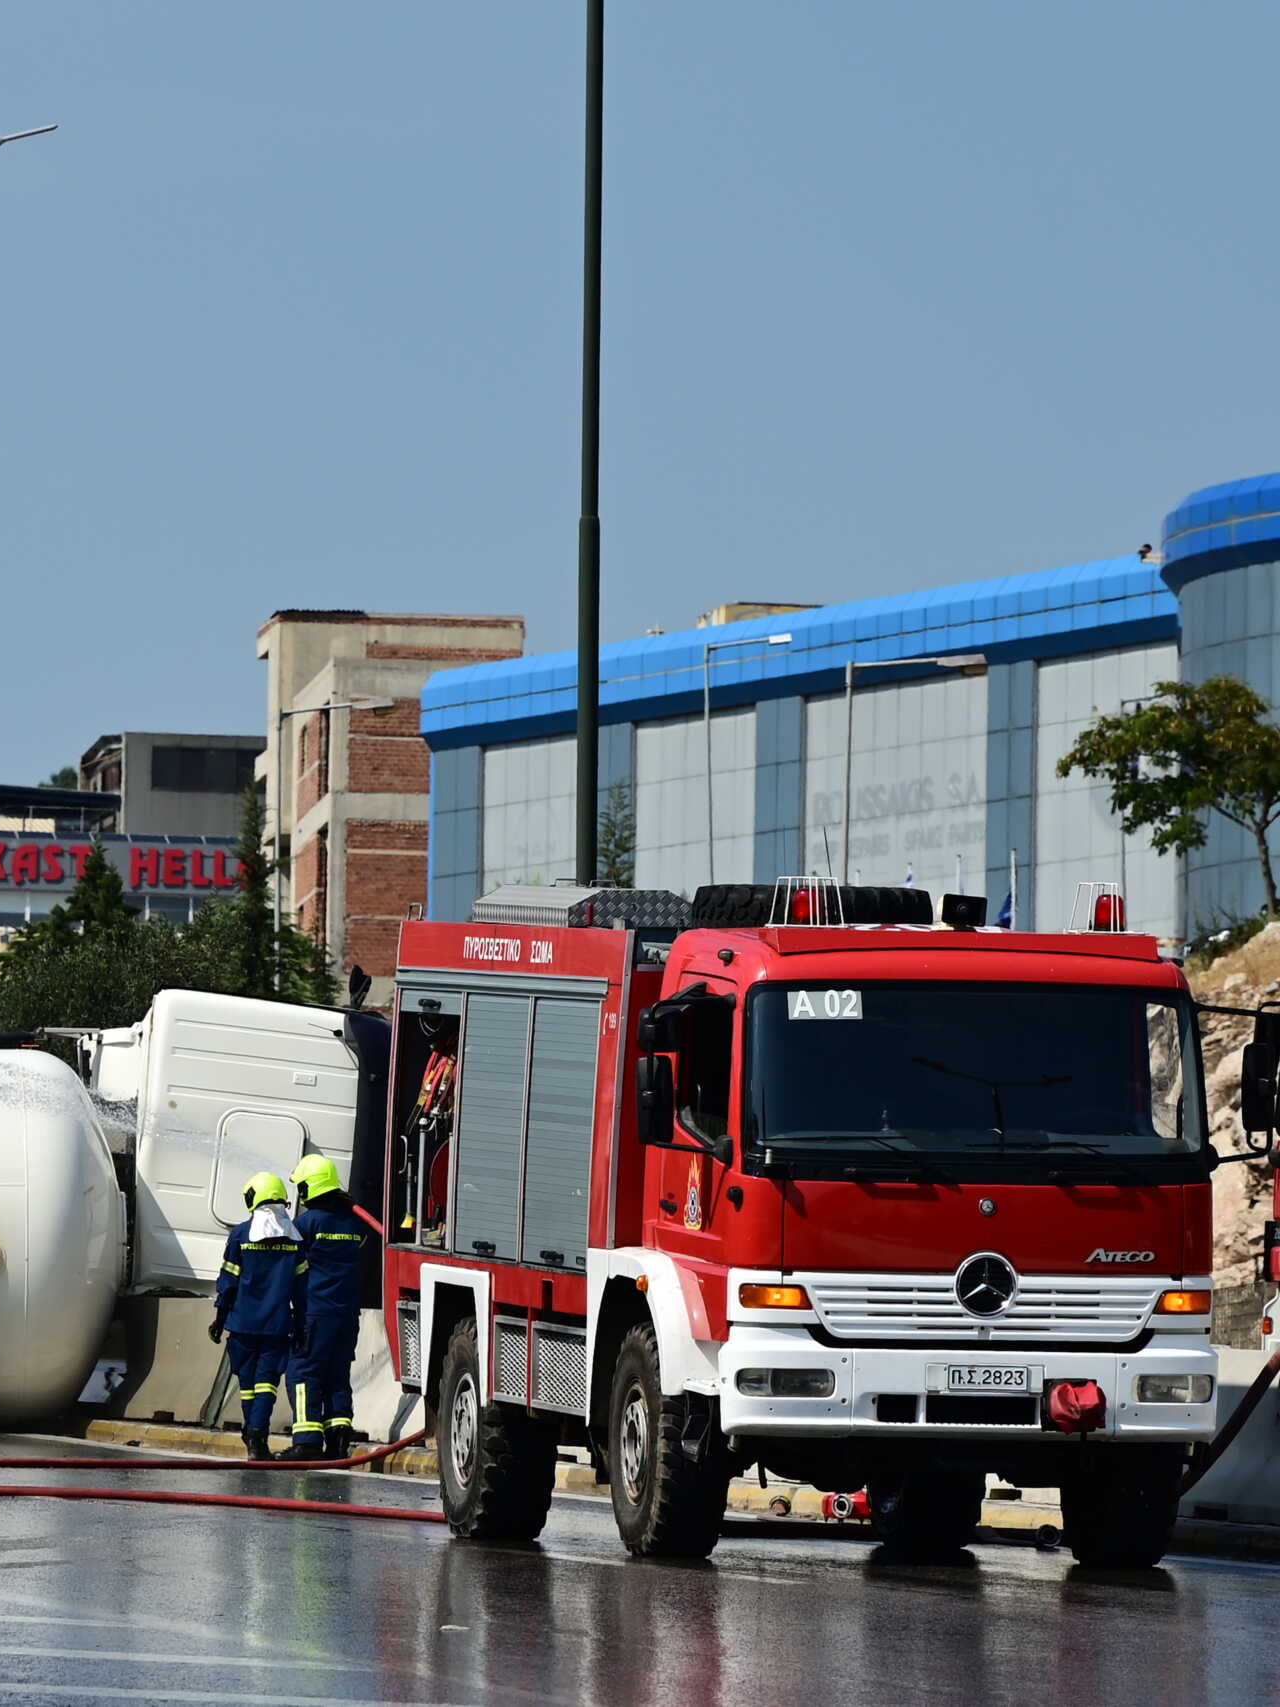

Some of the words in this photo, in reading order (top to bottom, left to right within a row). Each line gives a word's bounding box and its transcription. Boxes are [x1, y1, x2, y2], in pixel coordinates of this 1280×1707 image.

[463, 936, 521, 963] ΠΥΡΟΣΒΕΣΤΙΚΟ
[529, 940, 553, 964] ΣΩΜΑ
[824, 989, 858, 1018] 02
